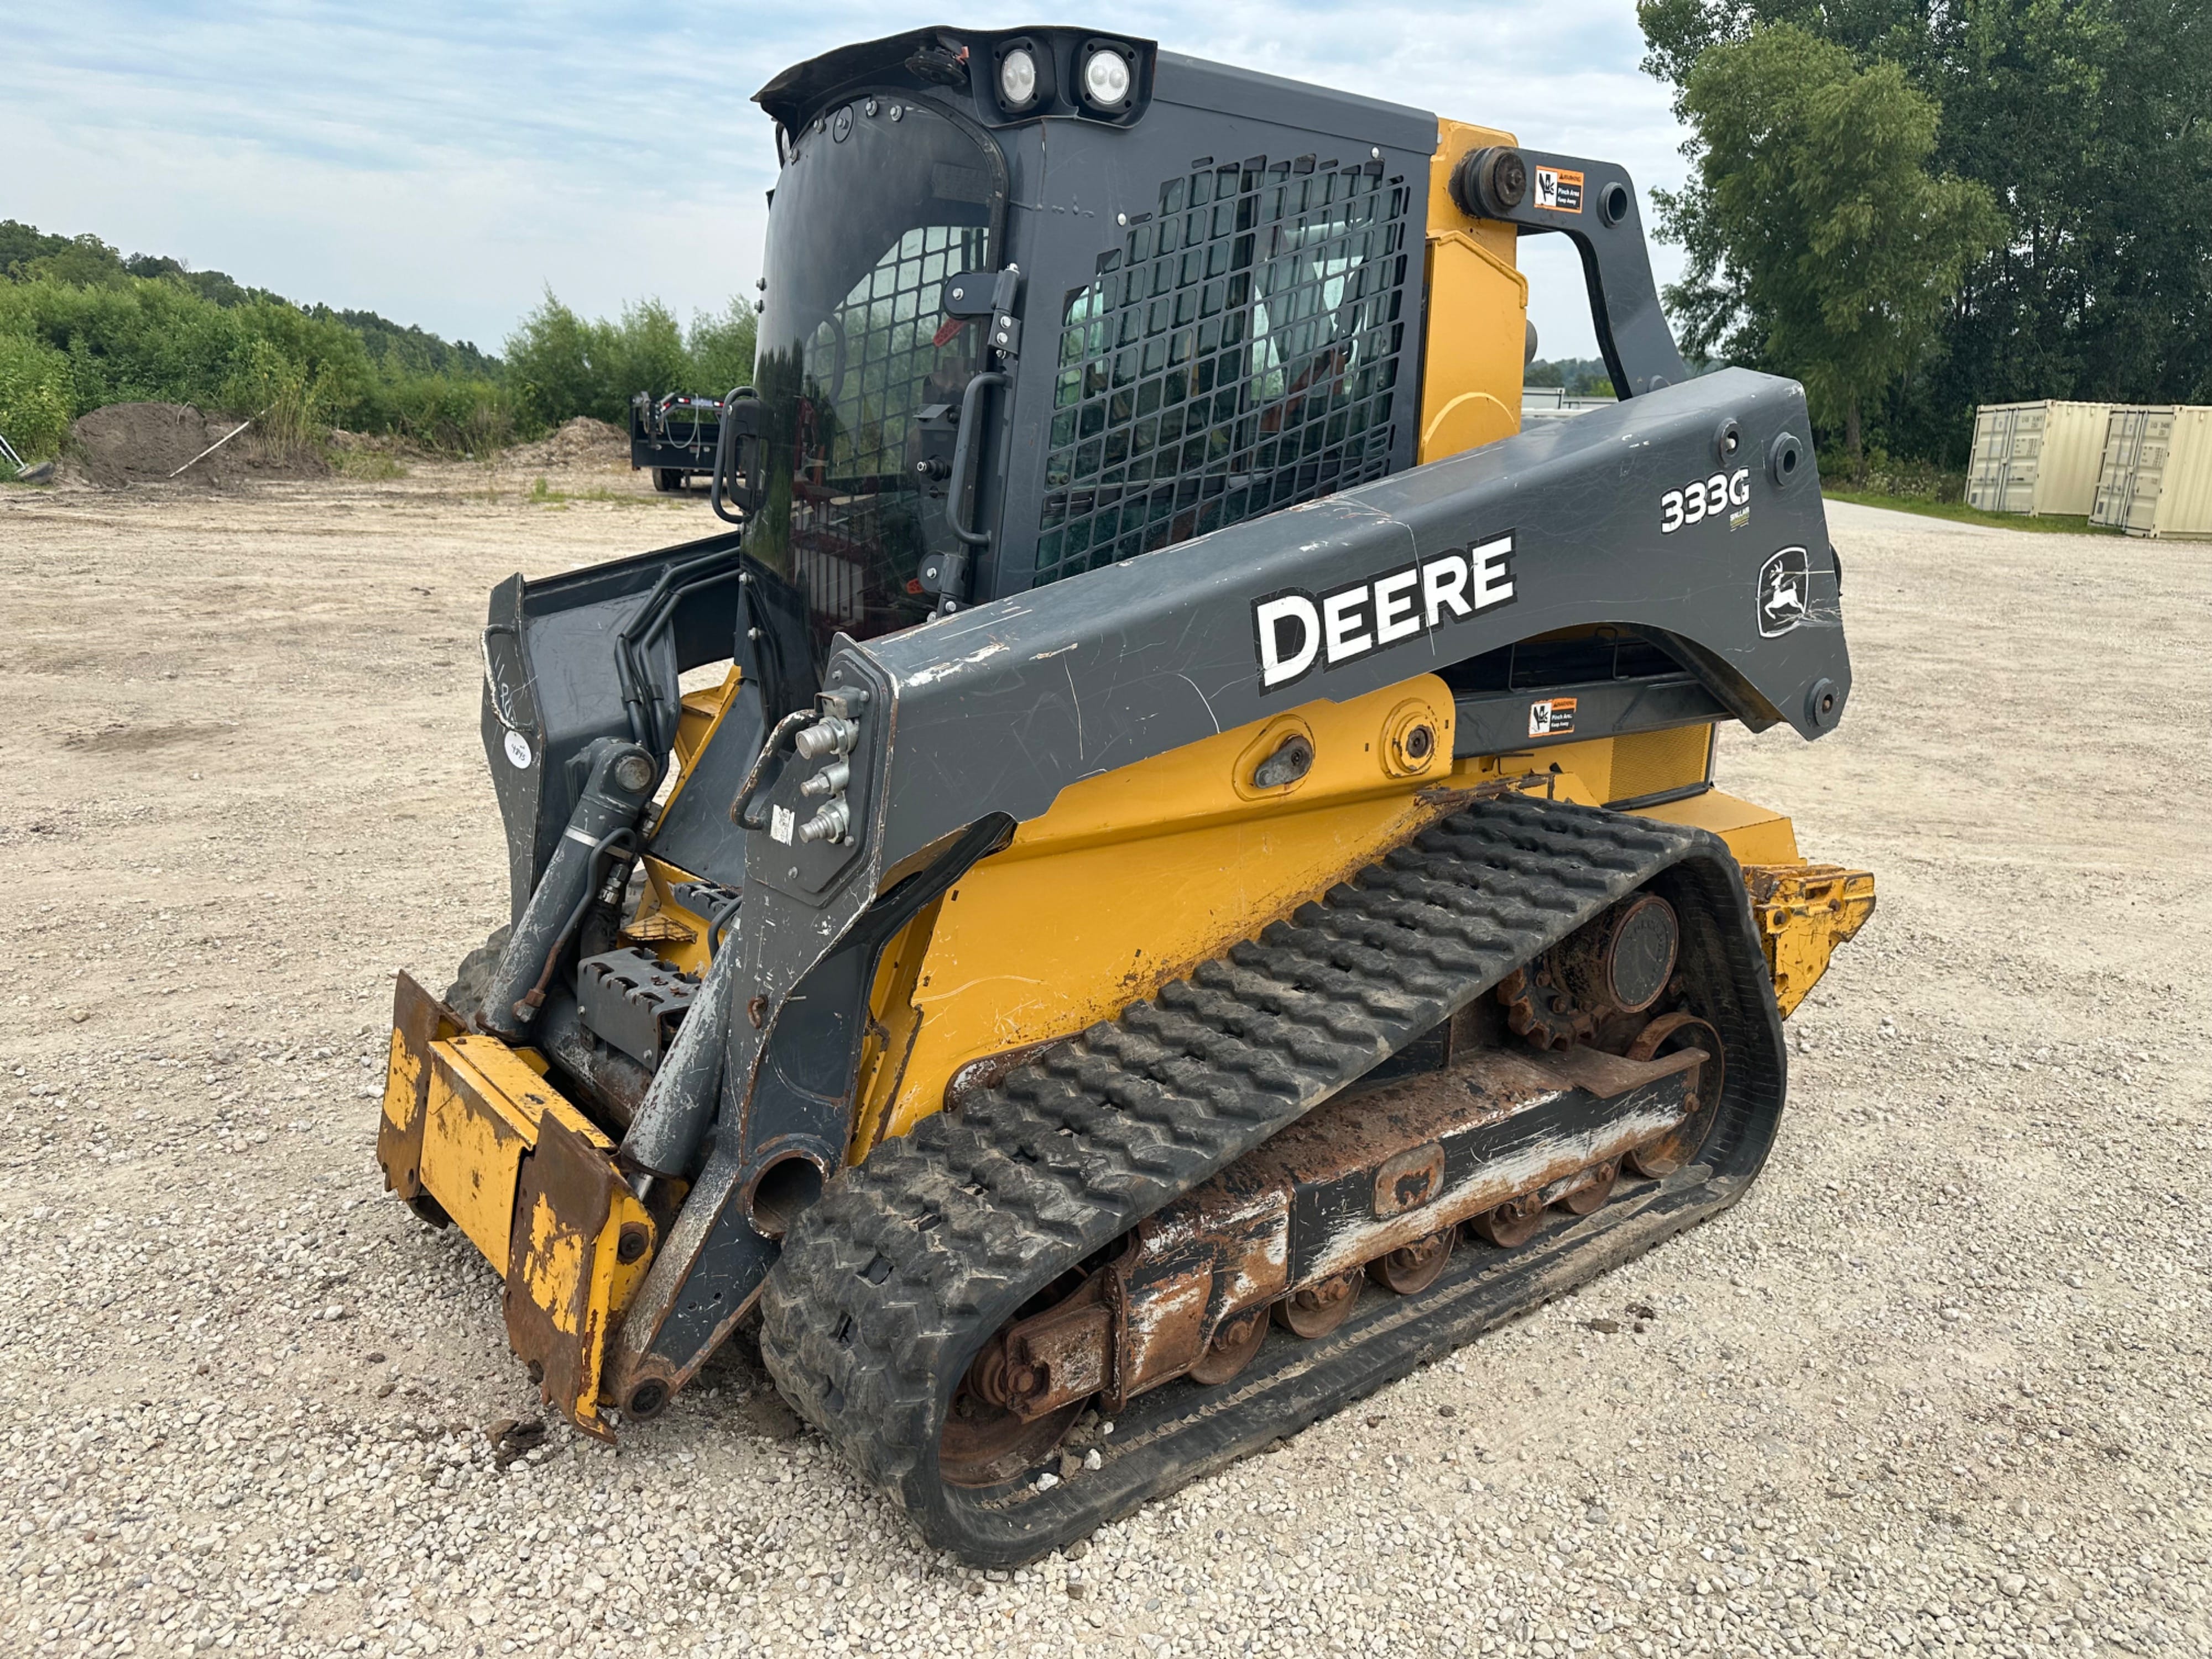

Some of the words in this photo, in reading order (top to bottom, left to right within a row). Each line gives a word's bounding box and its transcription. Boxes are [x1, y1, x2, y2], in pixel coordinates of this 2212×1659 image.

[1558, 187, 1569, 196] Pinch
[1661, 468, 1750, 533] 333G
[1257, 536, 1514, 687] DEERE
